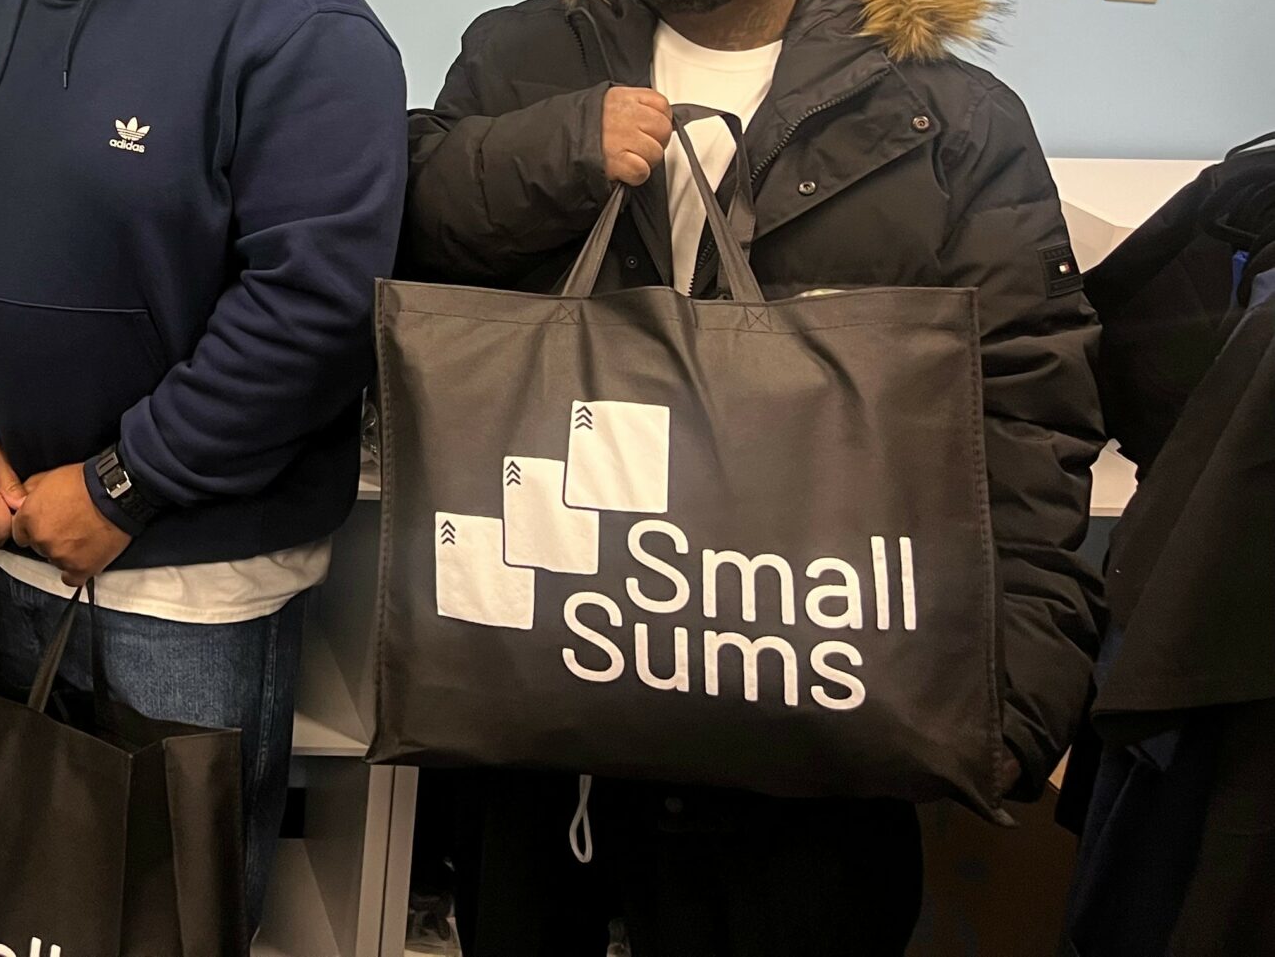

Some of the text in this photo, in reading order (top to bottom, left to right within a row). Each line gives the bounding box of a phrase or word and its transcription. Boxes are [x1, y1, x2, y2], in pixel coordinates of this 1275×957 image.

[109, 139, 145, 153] adidas
[625, 520, 916, 631] Small
[561, 591, 866, 710] Sums
